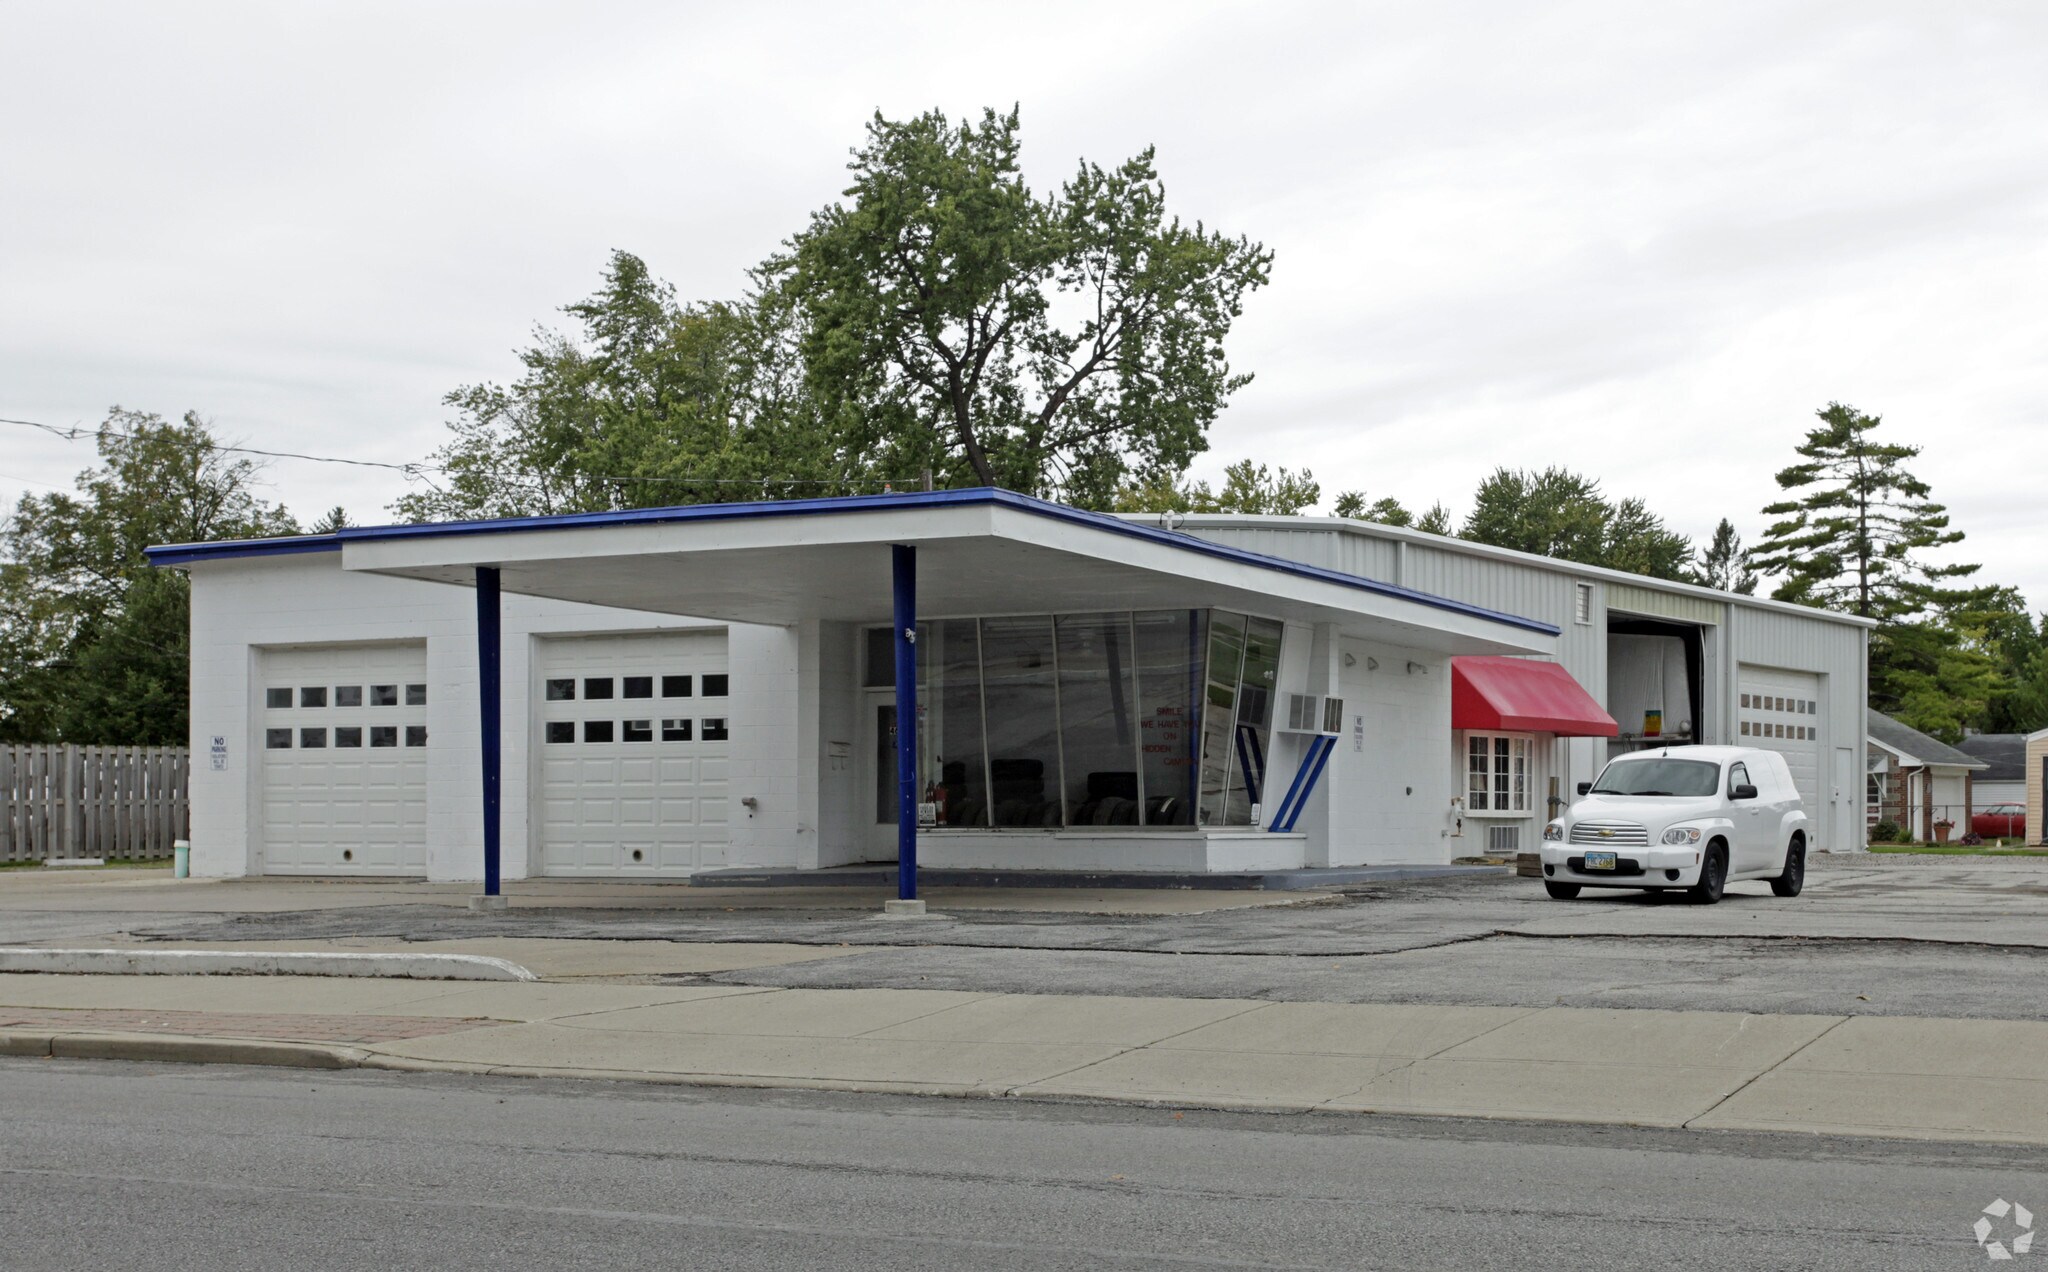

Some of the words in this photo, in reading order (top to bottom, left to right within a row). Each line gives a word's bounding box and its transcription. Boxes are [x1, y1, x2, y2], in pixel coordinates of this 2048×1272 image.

[1156, 706, 1184, 716] SMILE
[1141, 720, 1153, 729] WE
[1157, 720, 1179, 729] HAVE
[1162, 732, 1177, 740] ON
[214, 737, 224, 746] NO
[1141, 744, 1171, 752] HIDDEN
